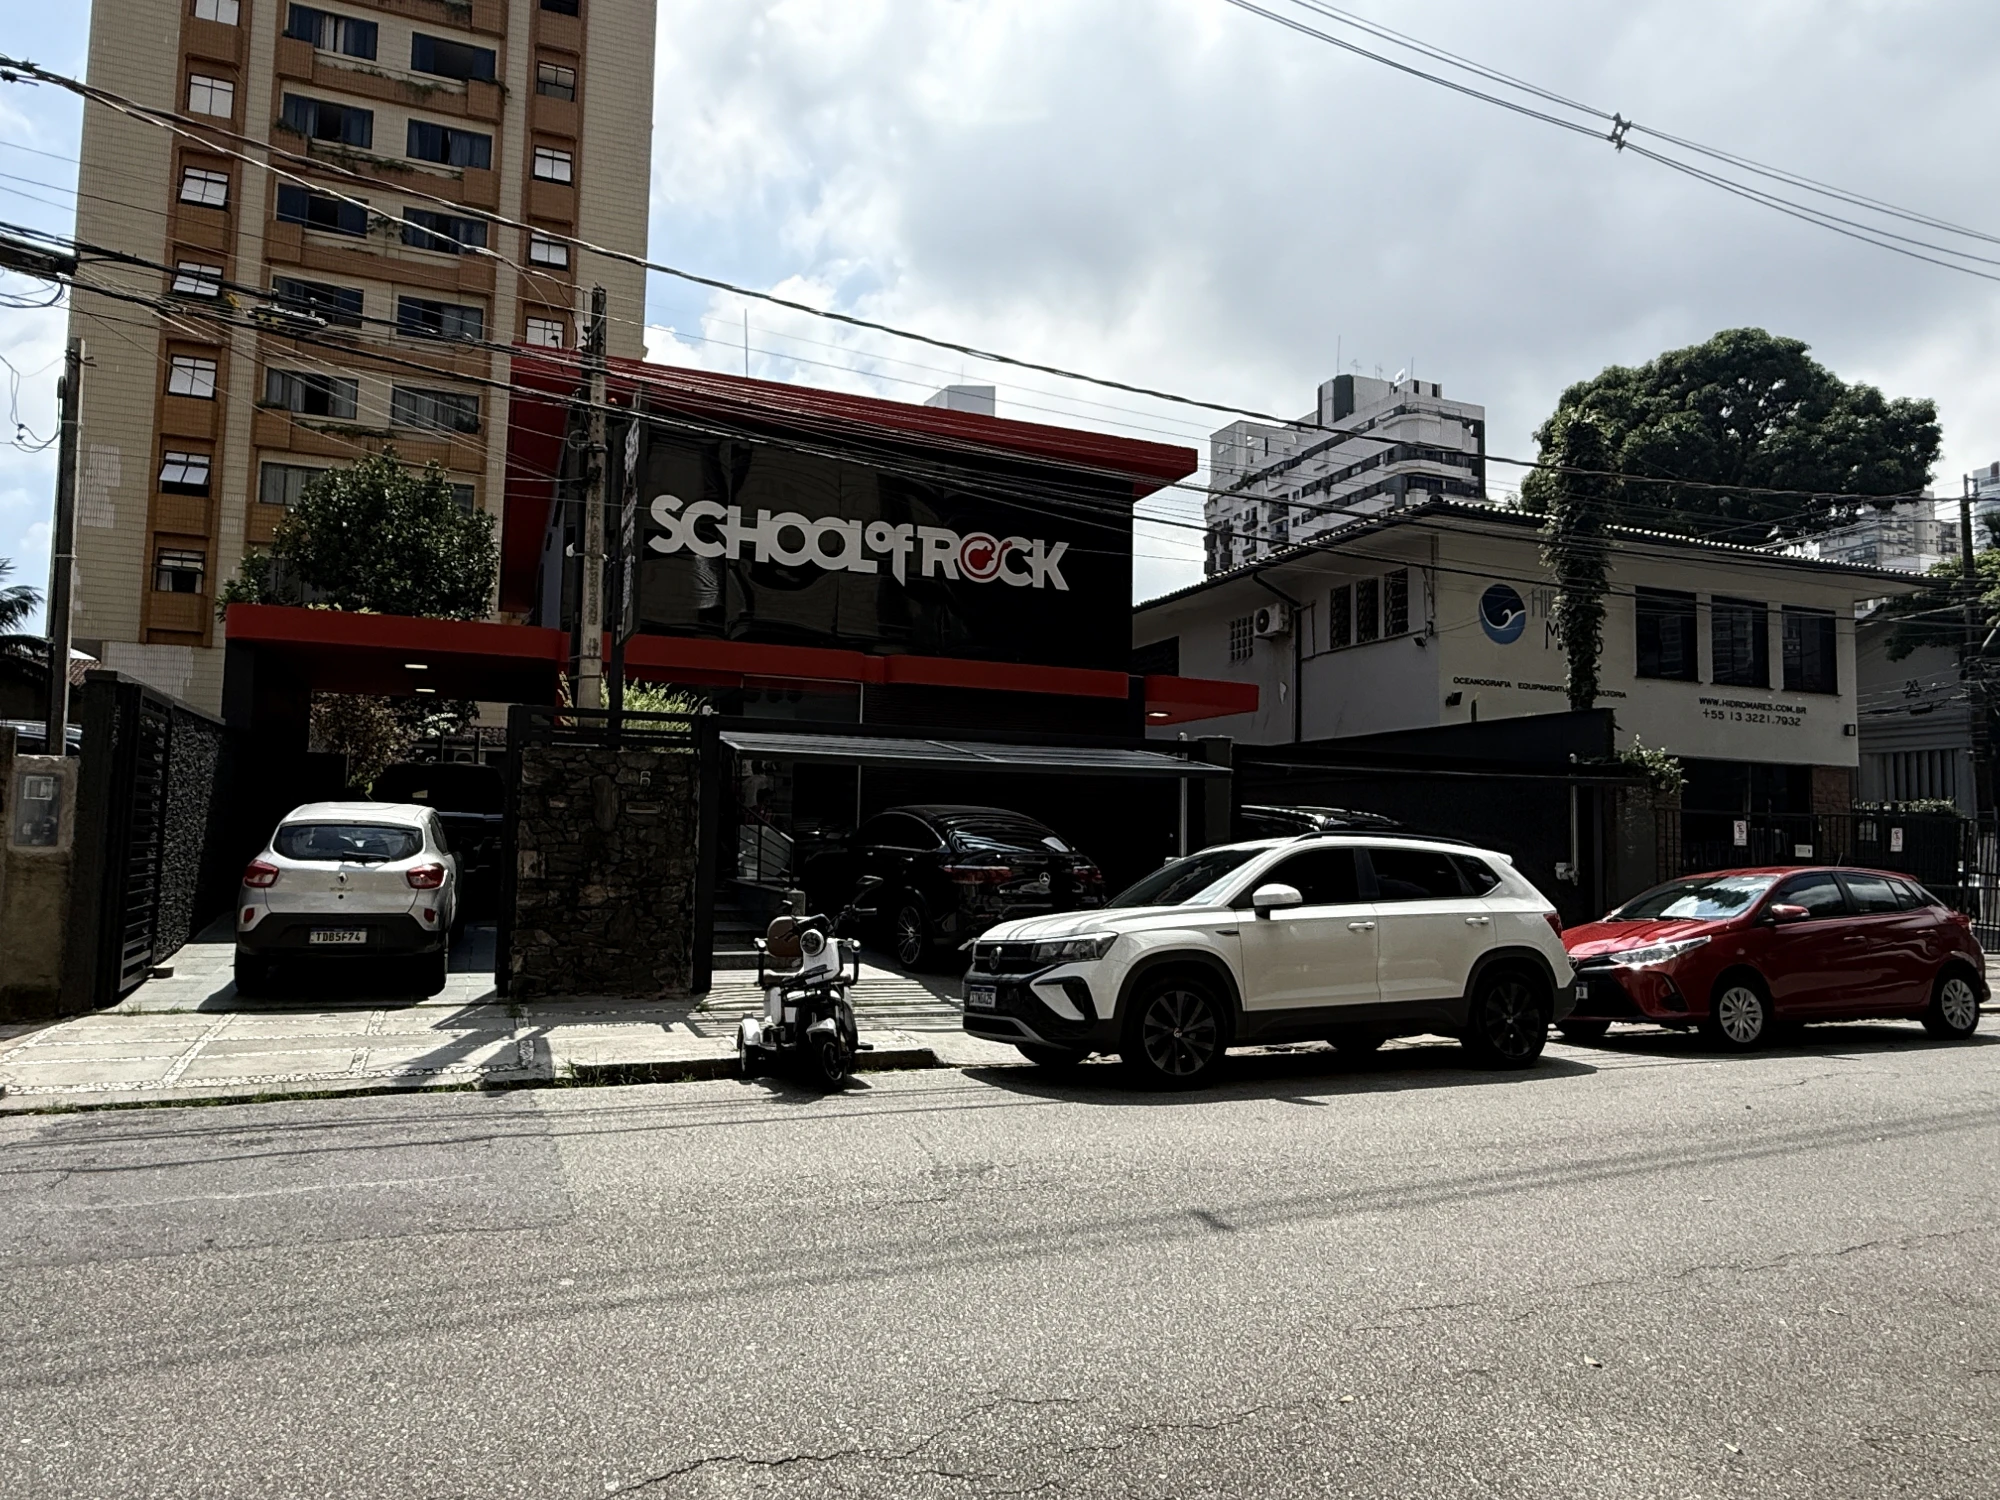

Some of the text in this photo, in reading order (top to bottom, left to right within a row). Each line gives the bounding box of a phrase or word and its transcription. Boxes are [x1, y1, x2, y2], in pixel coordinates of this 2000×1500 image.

[648, 494, 877, 574] SCHOOL
[917, 525, 1070, 591] ROCK
[1453, 676, 1511, 688] OCEANOGRAFIA
[1699, 697, 1807, 714] WWW.HIDROMARES.COM.BR
[1703, 708, 1802, 727] +55 13 3221.7932
